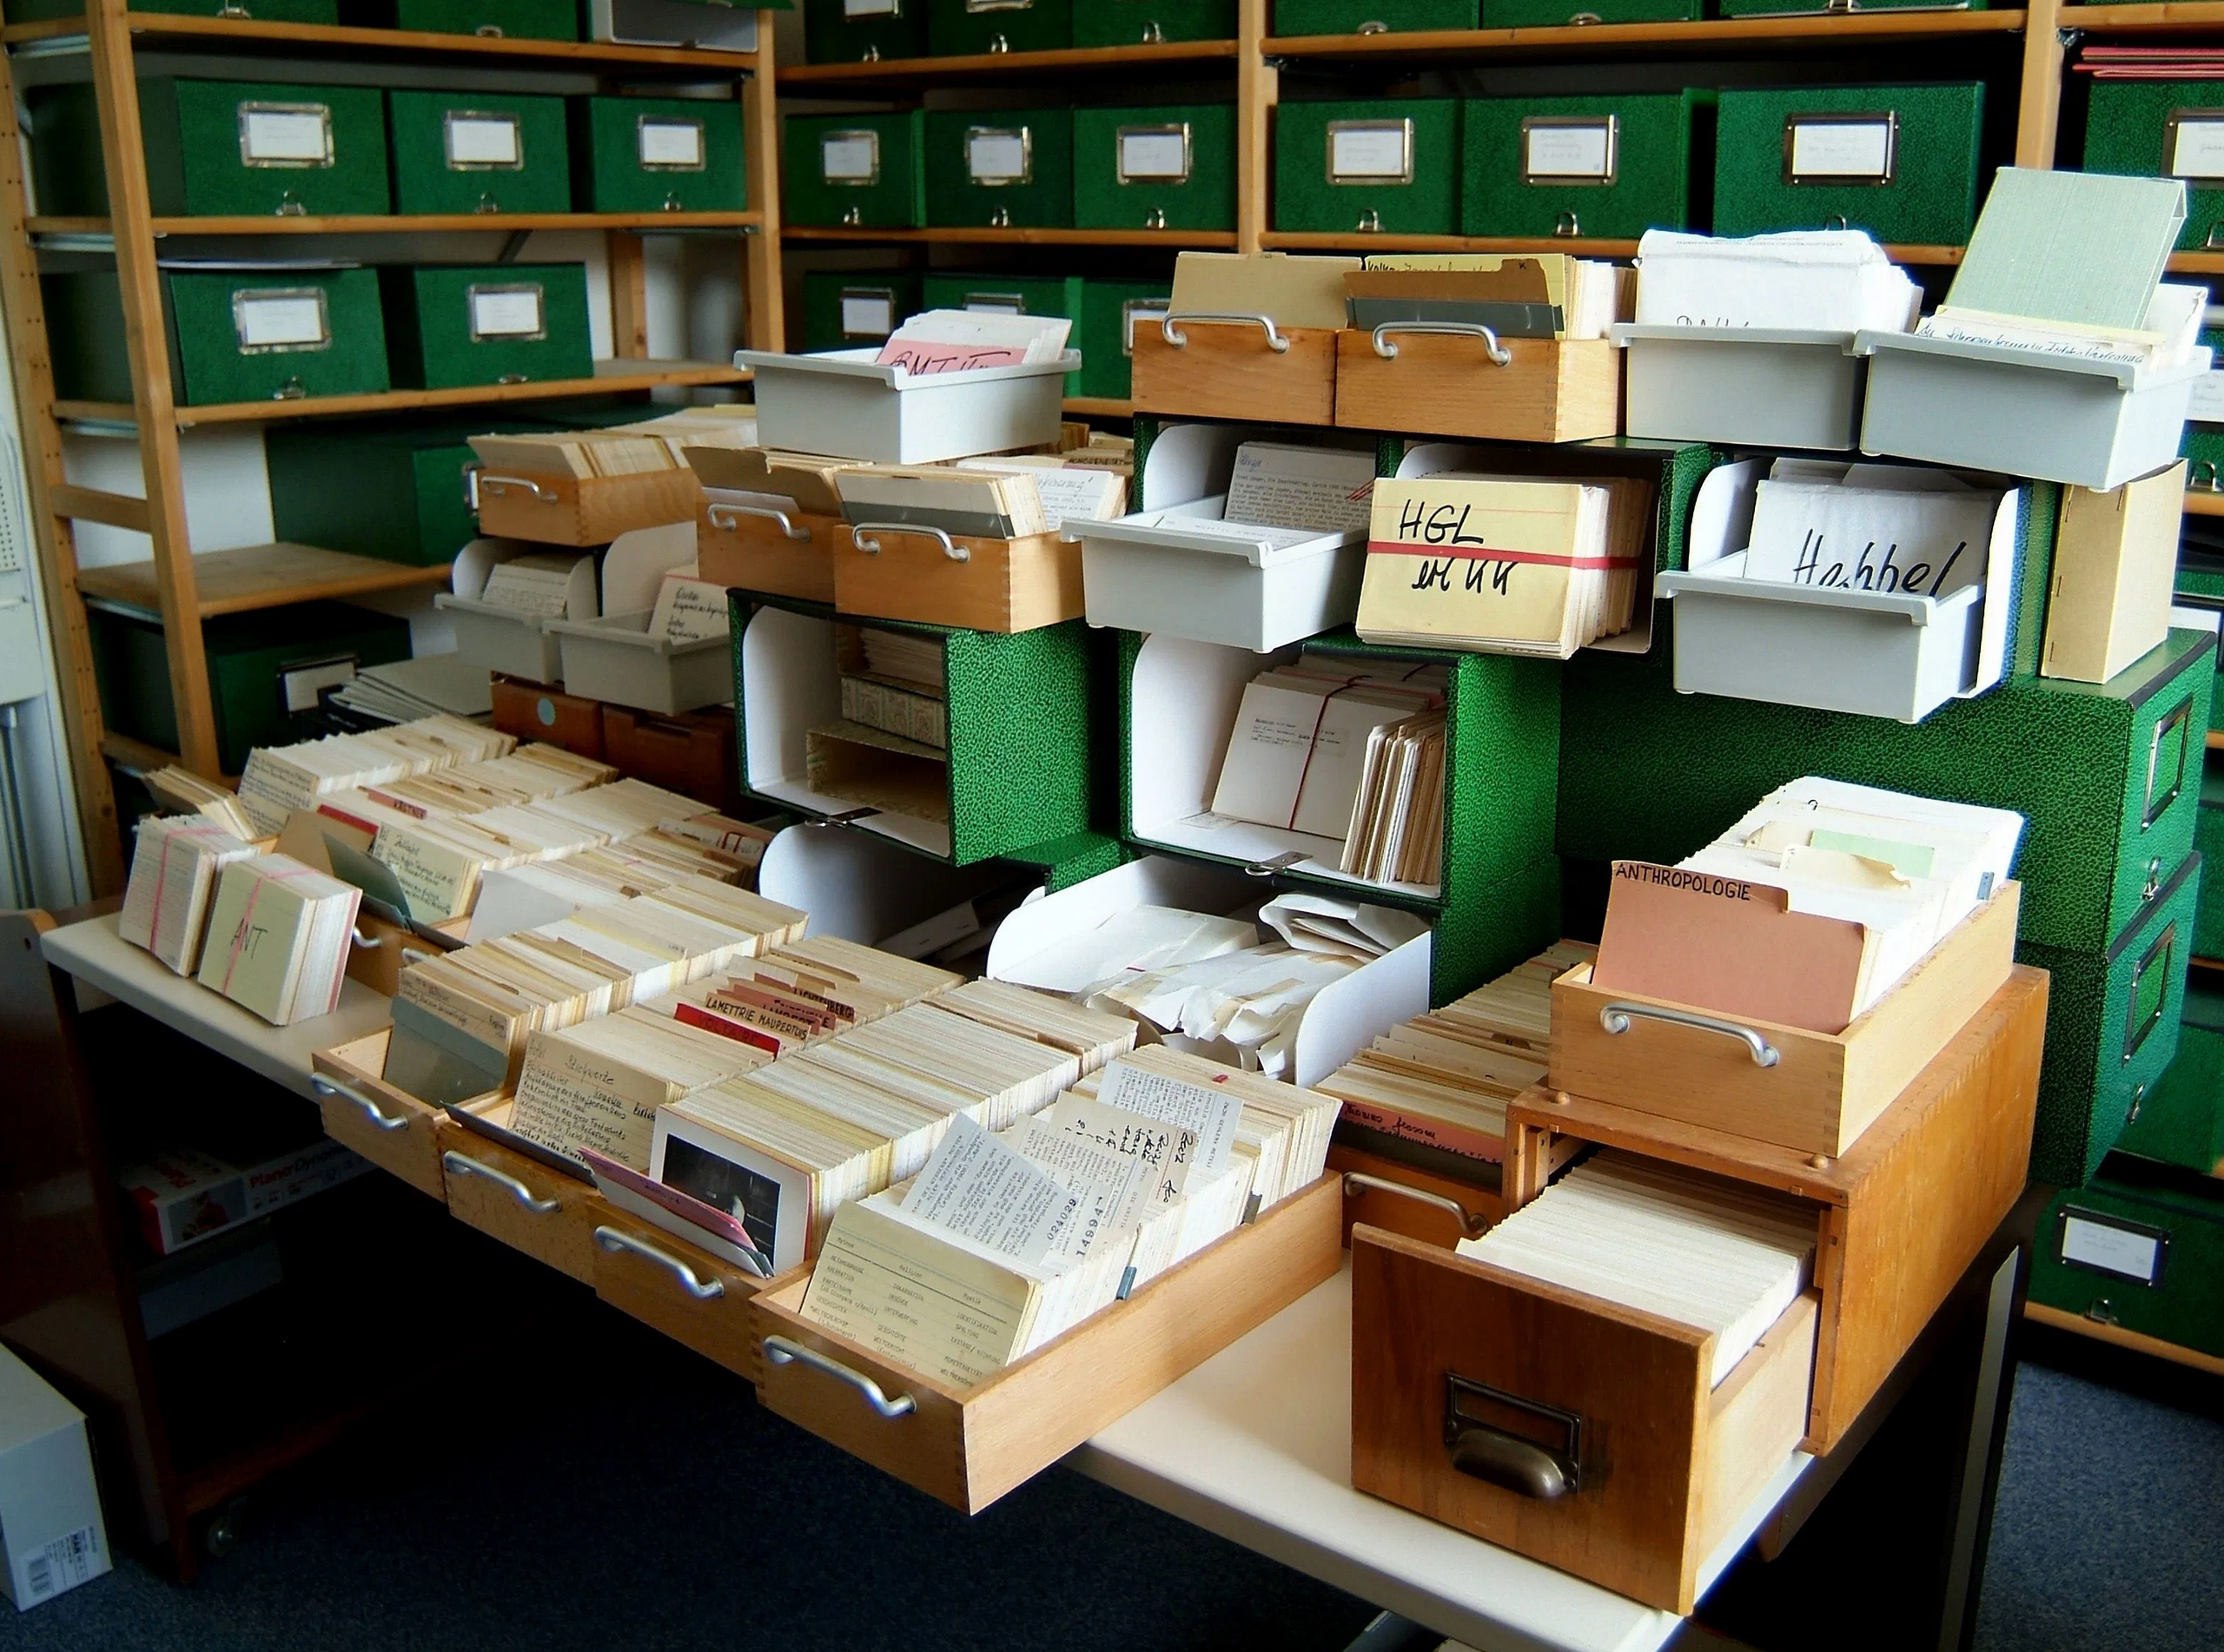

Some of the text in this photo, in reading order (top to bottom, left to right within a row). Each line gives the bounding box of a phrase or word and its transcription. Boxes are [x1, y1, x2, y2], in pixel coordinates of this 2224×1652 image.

[1400, 499, 1484, 544] HGL
[1616, 863, 1751, 901] ANTHROPOLOGIE
[699, 1014, 759, 1043] VOLTAIRE
[706, 997, 756, 1021] LAMETTRIE
[758, 1014, 809, 1040] MAUPERTUIS
[1047, 1199, 1076, 1240] 024029
[1076, 1206, 1103, 1256] 14994
